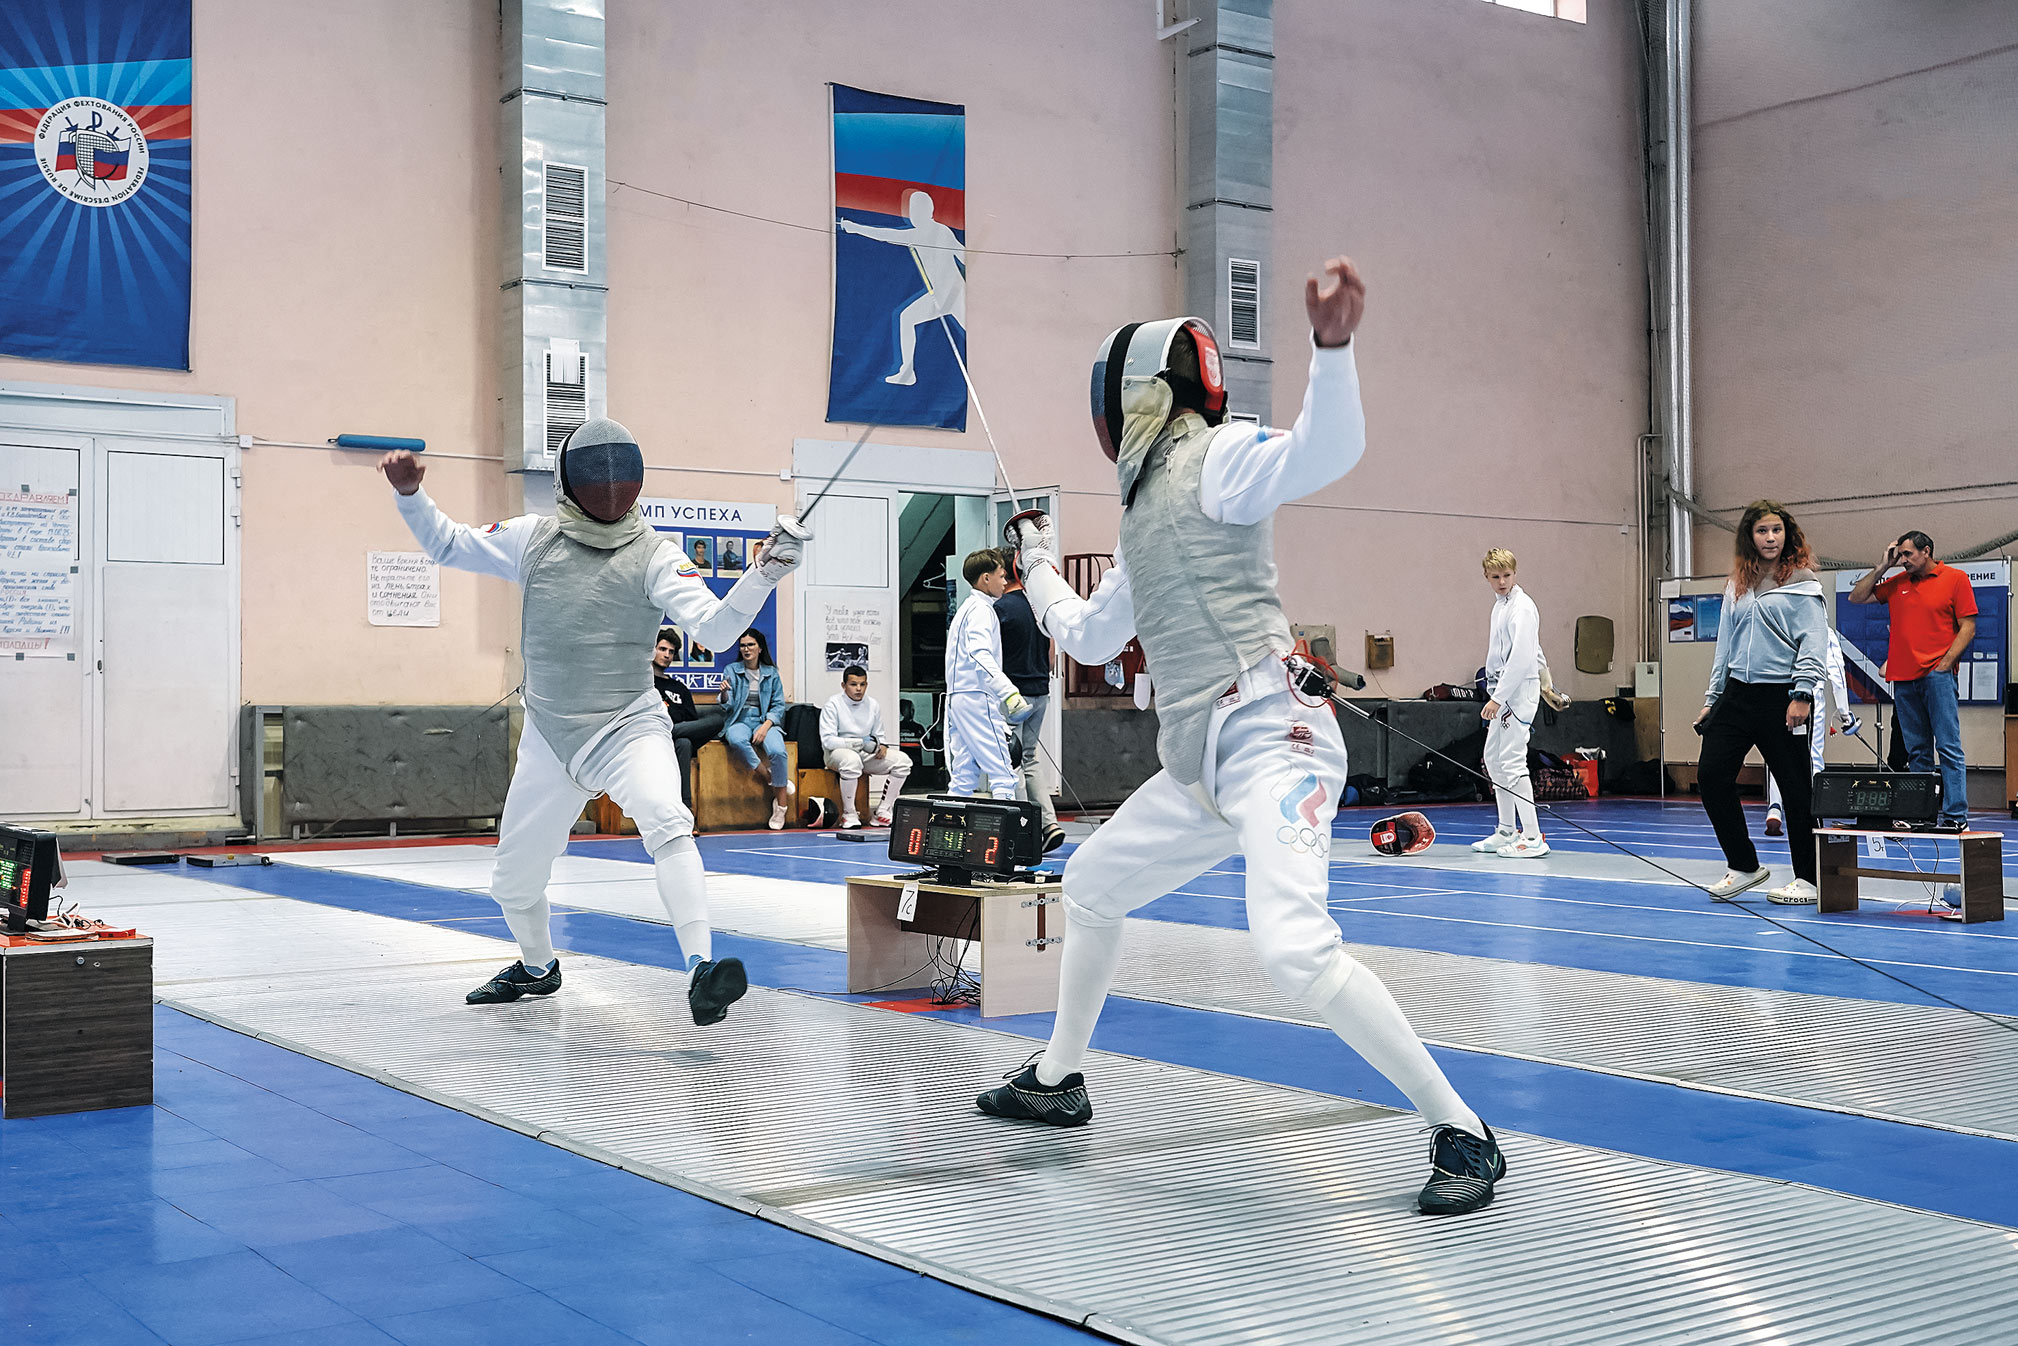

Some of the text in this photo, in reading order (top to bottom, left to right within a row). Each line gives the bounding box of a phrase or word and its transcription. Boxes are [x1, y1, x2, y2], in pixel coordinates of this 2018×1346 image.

[38, 100, 145, 154] ФЕДЕРАЦИЯ ФЕХТОВАНИЯ РОССИИ
[40, 158, 58, 183] RUSSIE
[58, 182, 68, 192] DE
[671, 506, 742, 522] УСПЕХА
[908, 828, 922, 855] 0
[985, 836, 998, 864] 2
